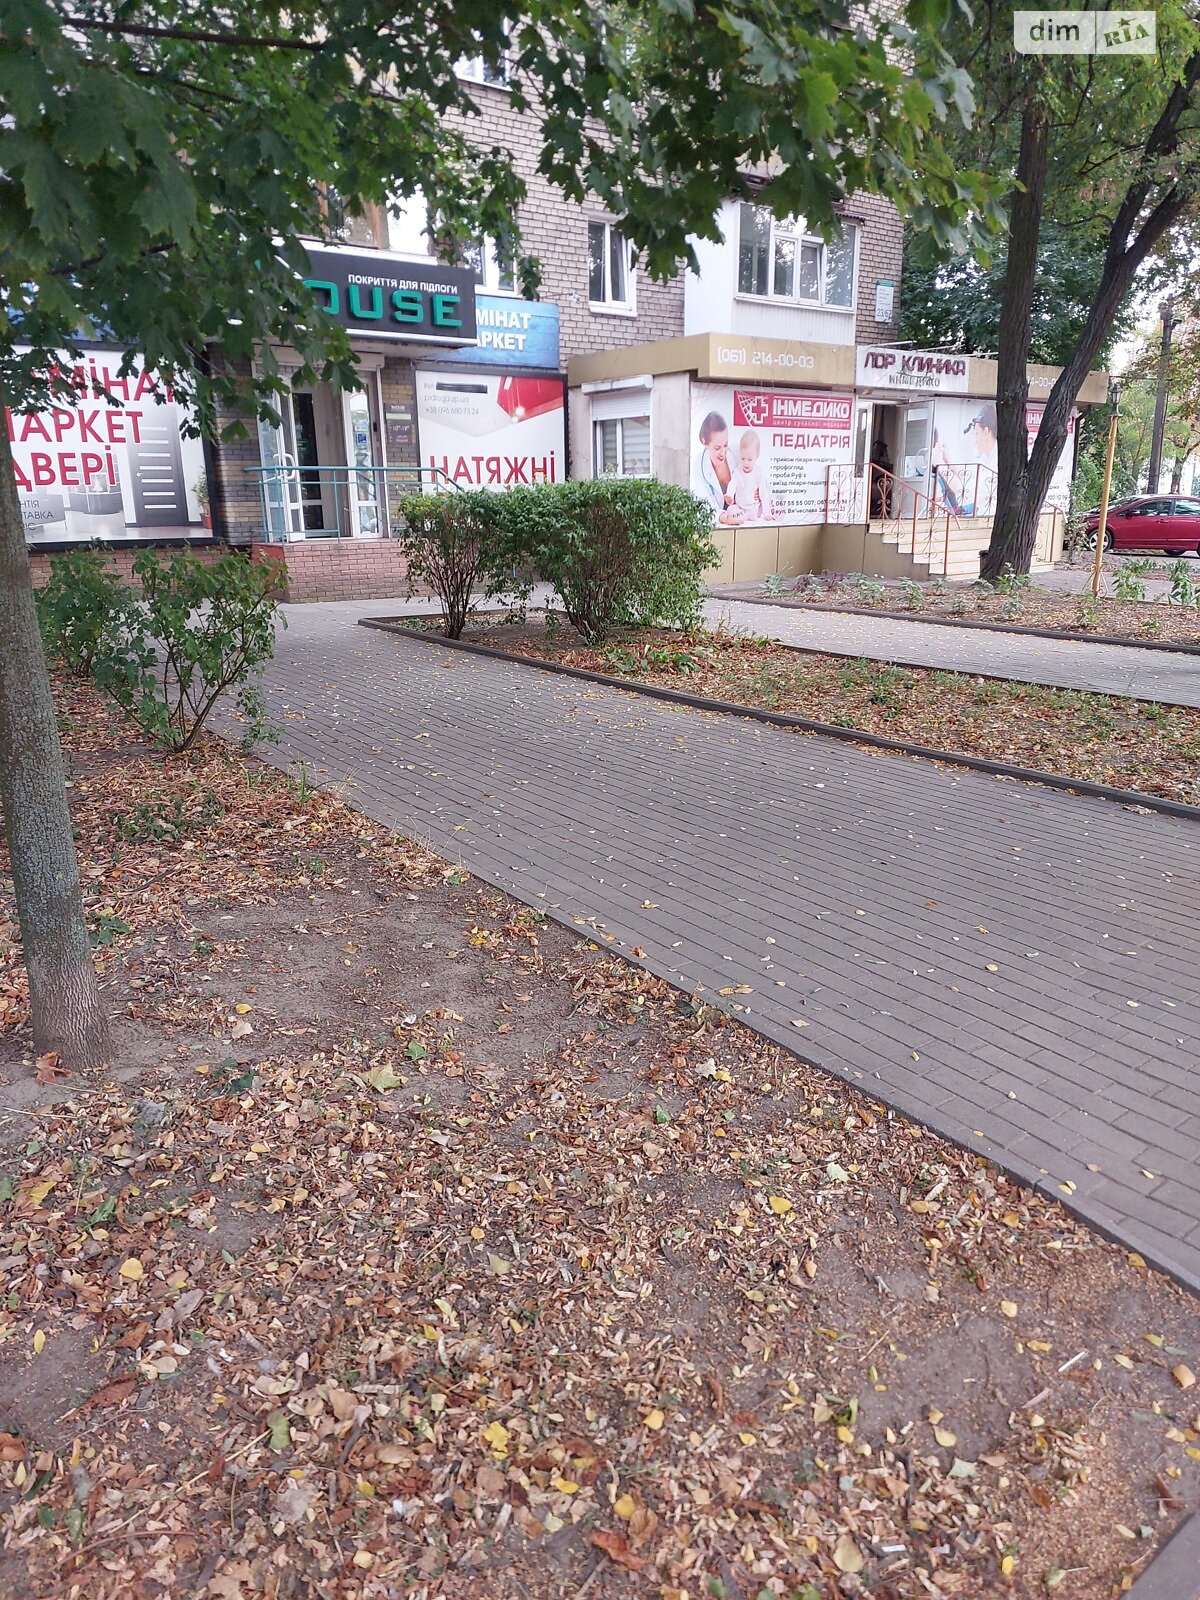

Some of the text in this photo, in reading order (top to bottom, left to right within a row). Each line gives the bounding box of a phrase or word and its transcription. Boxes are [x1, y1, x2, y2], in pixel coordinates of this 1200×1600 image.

[348, 273, 458, 295] ПОКРИТТЯ ДЛЯ ПІДЛОГИ
[301, 279, 463, 328] OUSE
[476, 308, 532, 330] МІНАТ
[717, 346, 815, 369] (061) 214-00-03
[864, 351, 966, 376] ЛОР КЛИНИКА
[772, 398, 850, 419] ІНМЕДИКО
[772, 433, 850, 449] ПЕДІАТРІЯ
[22, 511, 55, 520] ТАВКА
